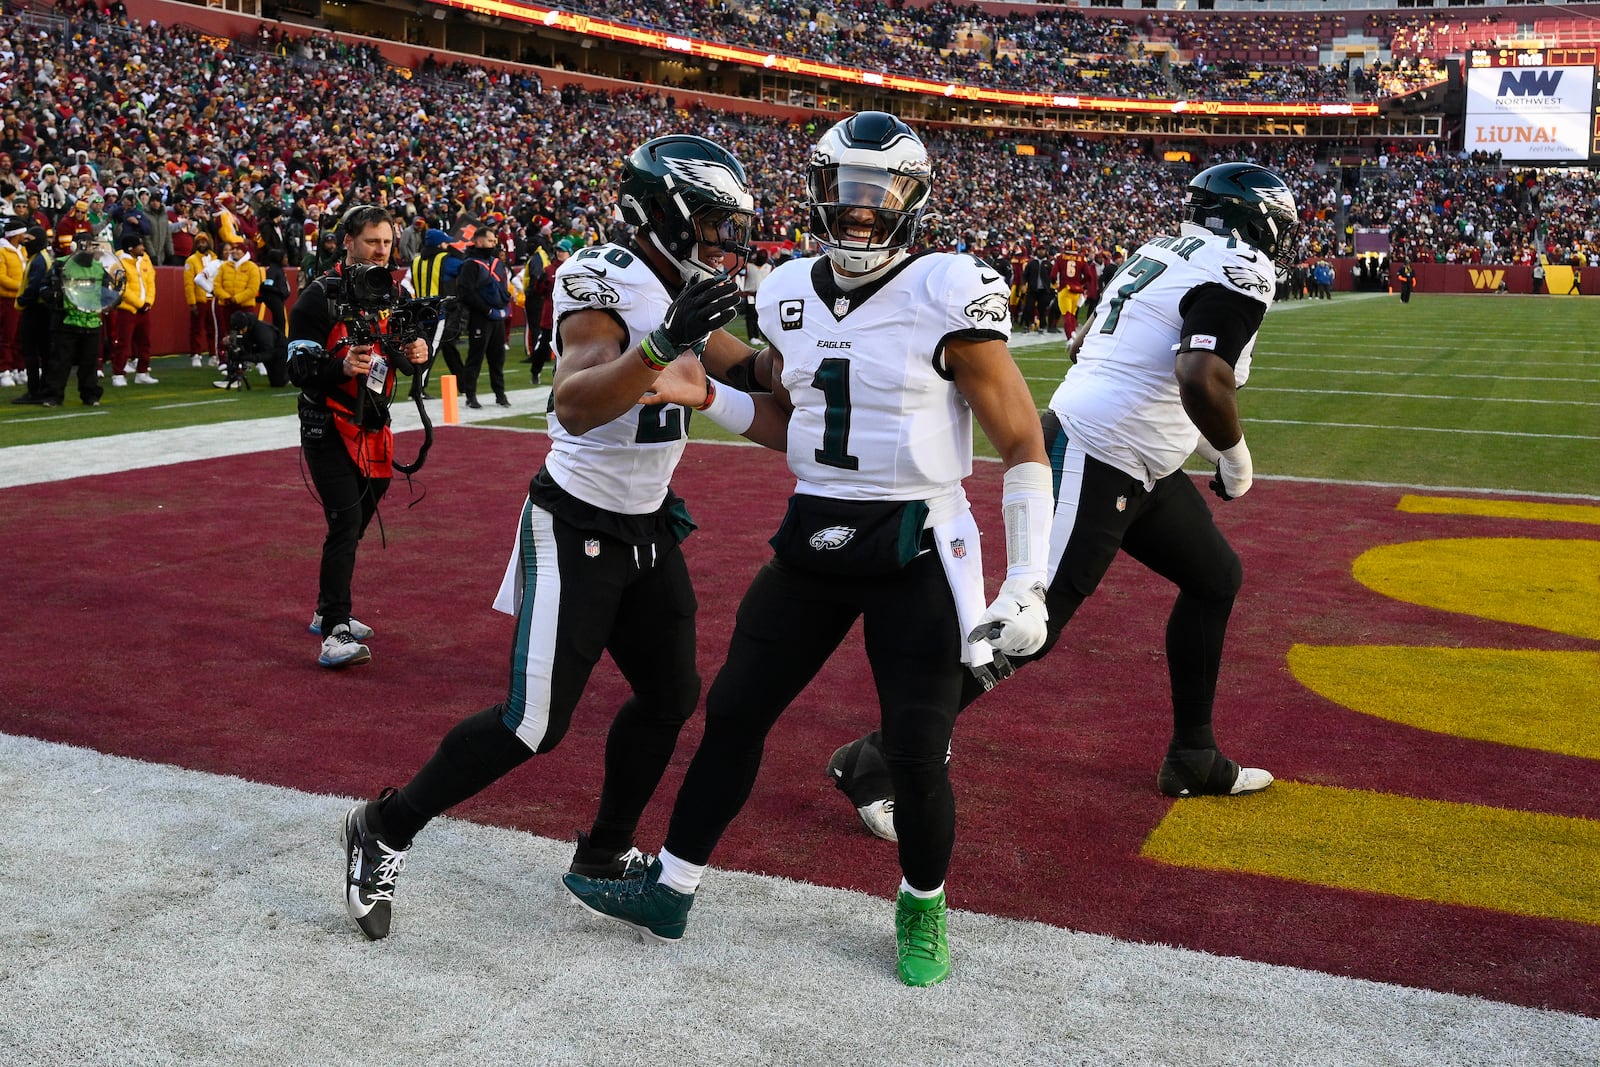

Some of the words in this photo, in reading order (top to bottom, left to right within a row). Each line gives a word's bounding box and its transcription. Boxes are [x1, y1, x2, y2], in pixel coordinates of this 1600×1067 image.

[1497, 70, 1564, 97] NW
[1495, 97, 1563, 105] NORTHWEST
[1475, 125, 1557, 143] LiUNA!
[40, 191, 55, 208] 91
[1066, 260, 1076, 278] 6
[780, 300, 802, 323] C
[817, 340, 852, 349] EAGLES
[811, 358, 859, 471] 1
[953, 547, 966, 557] NFL
